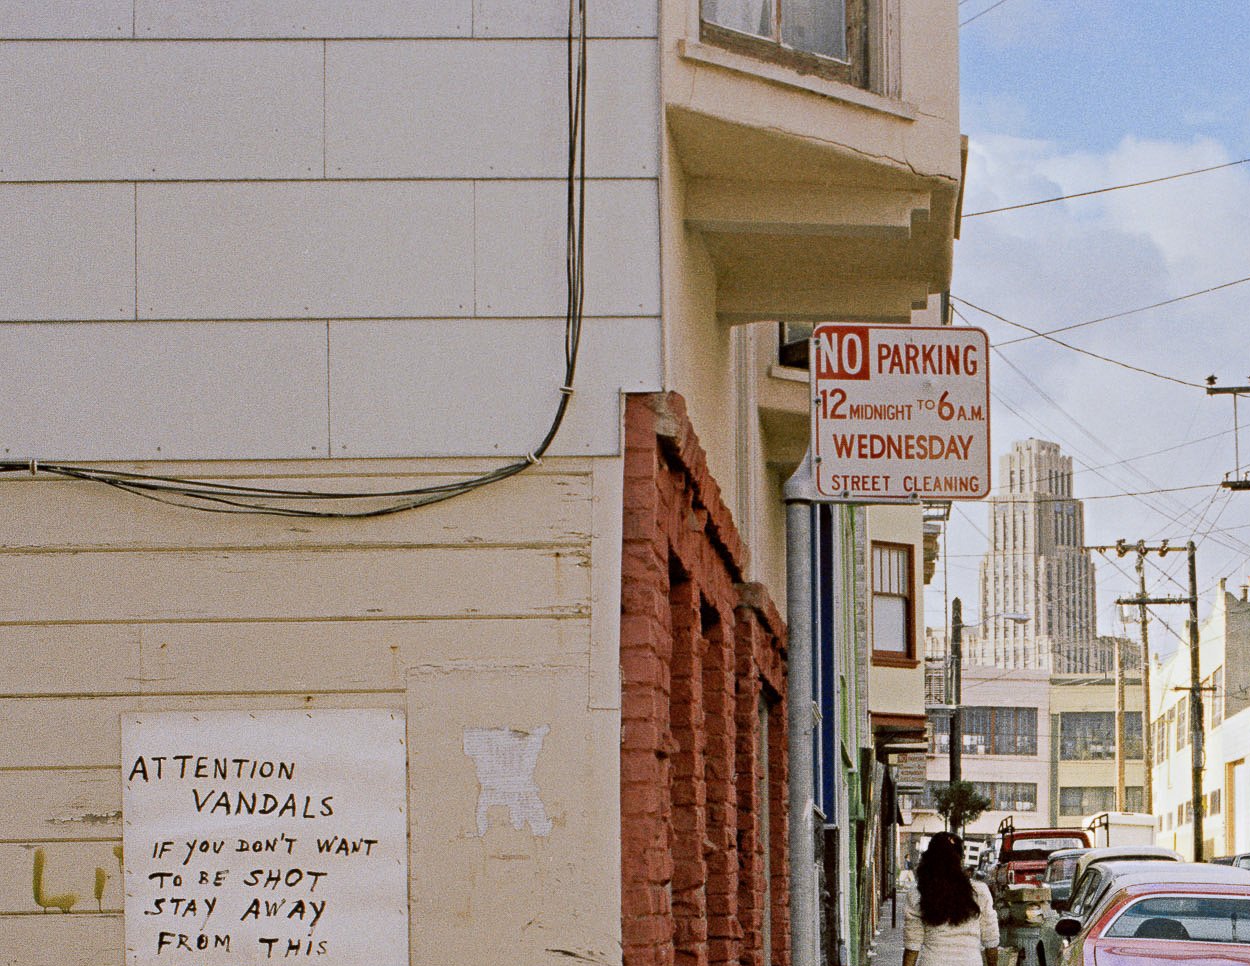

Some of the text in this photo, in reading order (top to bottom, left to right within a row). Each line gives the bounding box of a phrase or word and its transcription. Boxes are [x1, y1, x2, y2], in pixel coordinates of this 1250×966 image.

[820, 332, 978, 376] NO PARKING
[820, 388, 985, 422] 12 MIDNIGHT TO 6 A.M.
[832, 434, 975, 461] WEDNESDAY
[831, 475, 980, 492] STREET CLEANING
[128, 755, 296, 783] ATTENTION
[192, 789, 335, 818] VANDALS
[152, 832, 378, 865] IF YOU DON'T WANT
[32, 846, 123, 912] LI
[148, 868, 328, 892] TO BE SHOT
[144, 897, 327, 927] STAY AWAY
[157, 931, 231, 955] FROM
